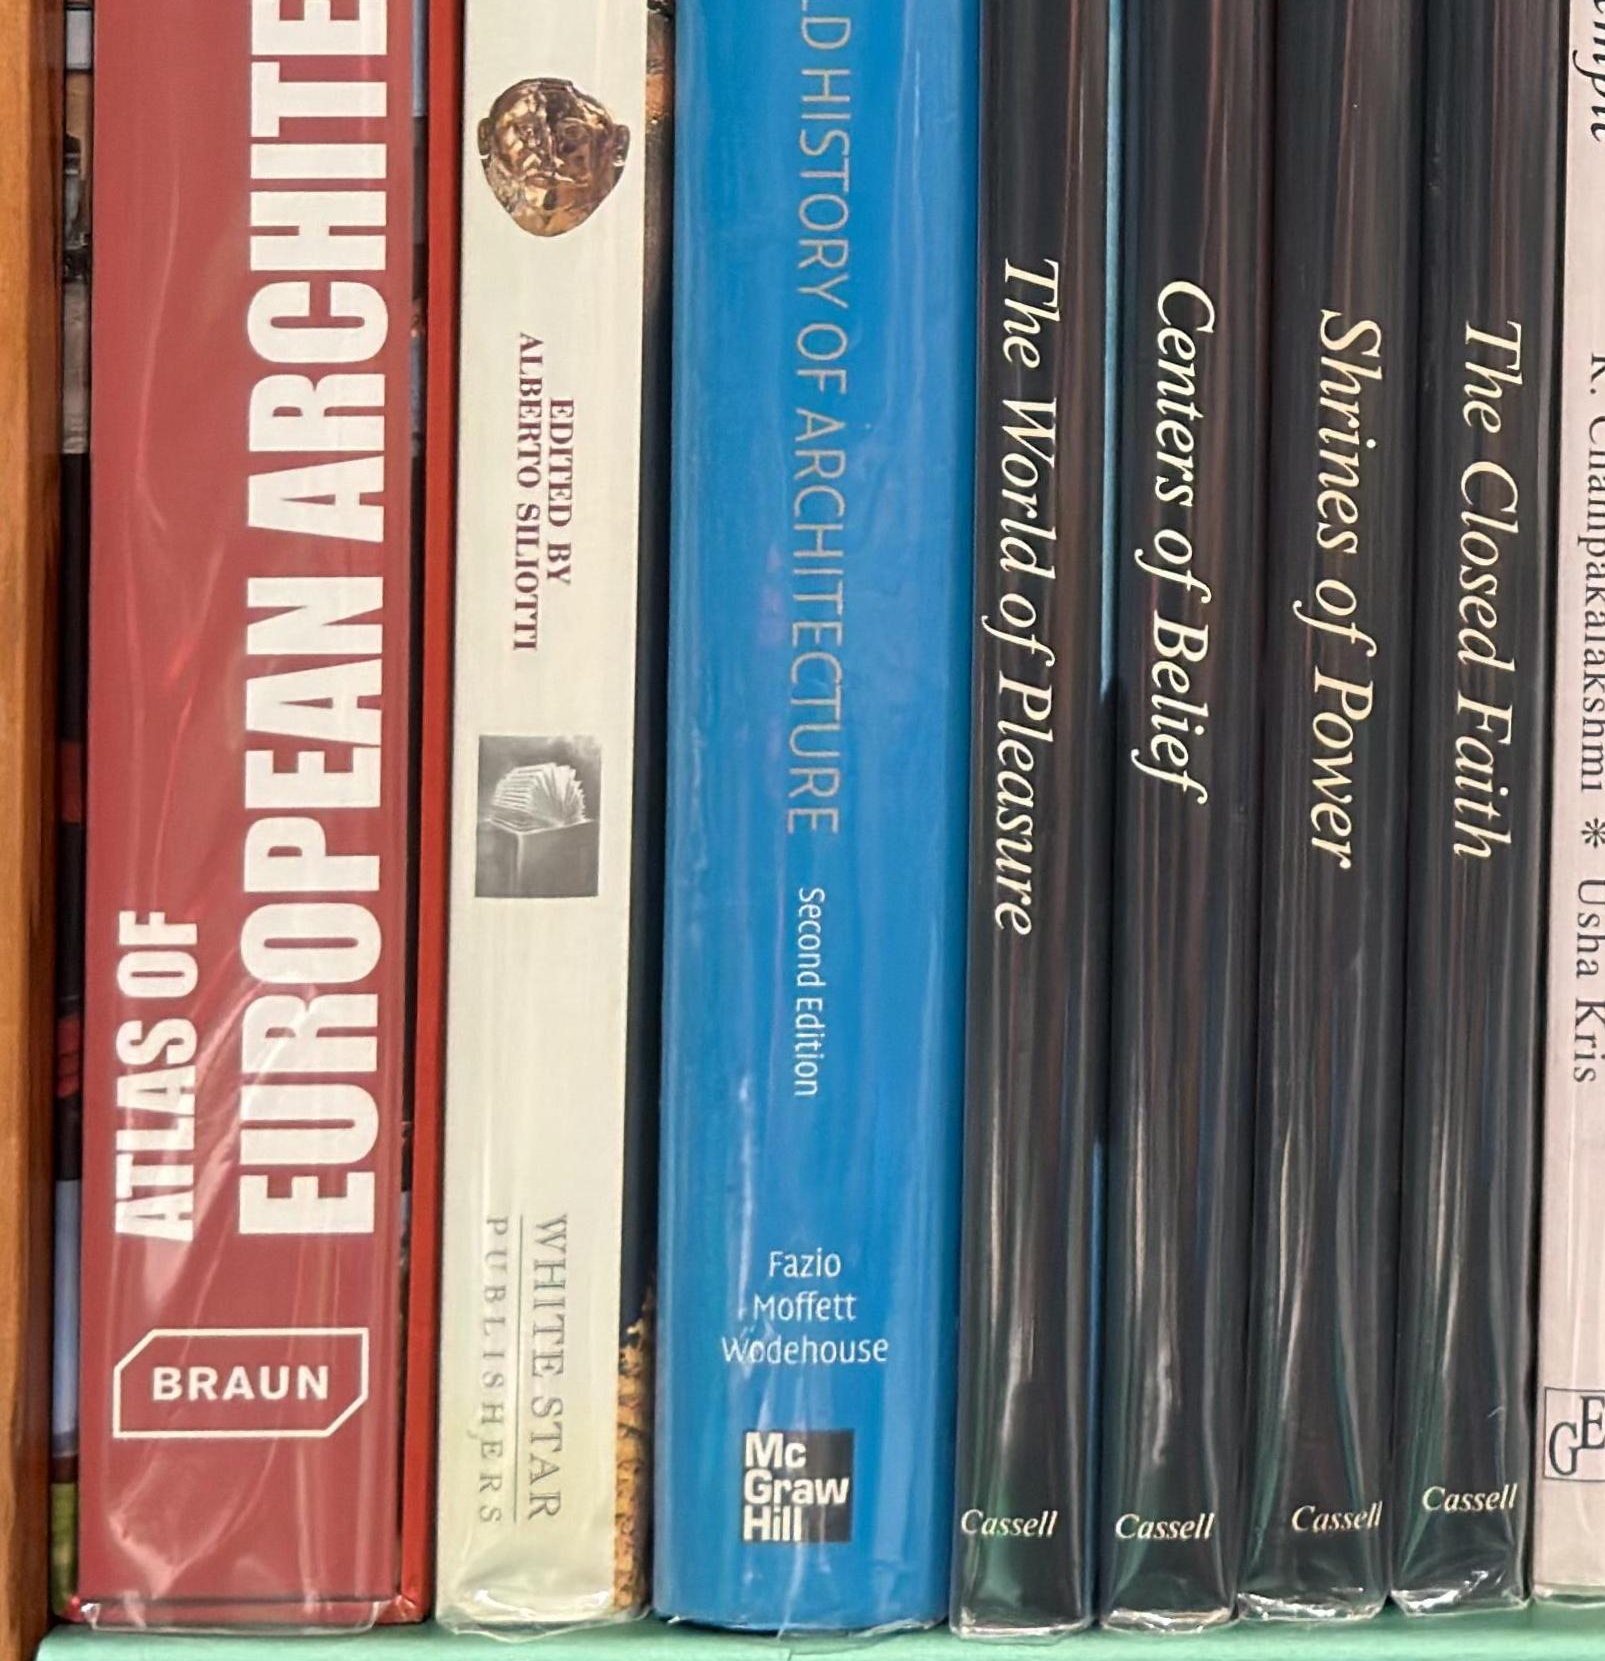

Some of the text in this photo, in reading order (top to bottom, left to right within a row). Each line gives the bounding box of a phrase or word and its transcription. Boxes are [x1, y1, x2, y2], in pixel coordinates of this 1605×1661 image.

[797, 70, 852, 310] HISTORY
[796, 323, 848, 396] OF
[513, 333, 545, 650] ALBERTO SILIOTTI
[545, 399, 575, 586] EDITED BY
[1131, 279, 1216, 804] Centers of Belief
[786, 408, 847, 834] ARCHITECTURE
[982, 258, 1060, 936] The World of Pleasure
[1294, 309, 1383, 869] Shrines of Power
[1453, 319, 1522, 861] The Closed Faith
[237, 576, 385, 1236] EUROPEAN
[793, 887, 826, 1097] Second Edition
[113, 909, 199, 1242] ATLAS OF
[722, 1334, 888, 1366] Wodehouse
[752, 1291, 857, 1324] Moffett
[768, 1248, 841, 1280] Fazio
[152, 1365, 328, 1401] BRAUN
[478, 1216, 509, 1525] PUBLISHERS
[526, 1213, 569, 1522] WHITE STAR
[745, 1435, 806, 1467] Mc
[744, 1471, 849, 1507] Graw
[745, 1506, 802, 1543] Hill
[960, 1510, 1058, 1540] Cassell
[1115, 1512, 1213, 1541] Cassell
[1291, 1500, 1382, 1534] Cassell
[1422, 1483, 1517, 1515] Cassell
